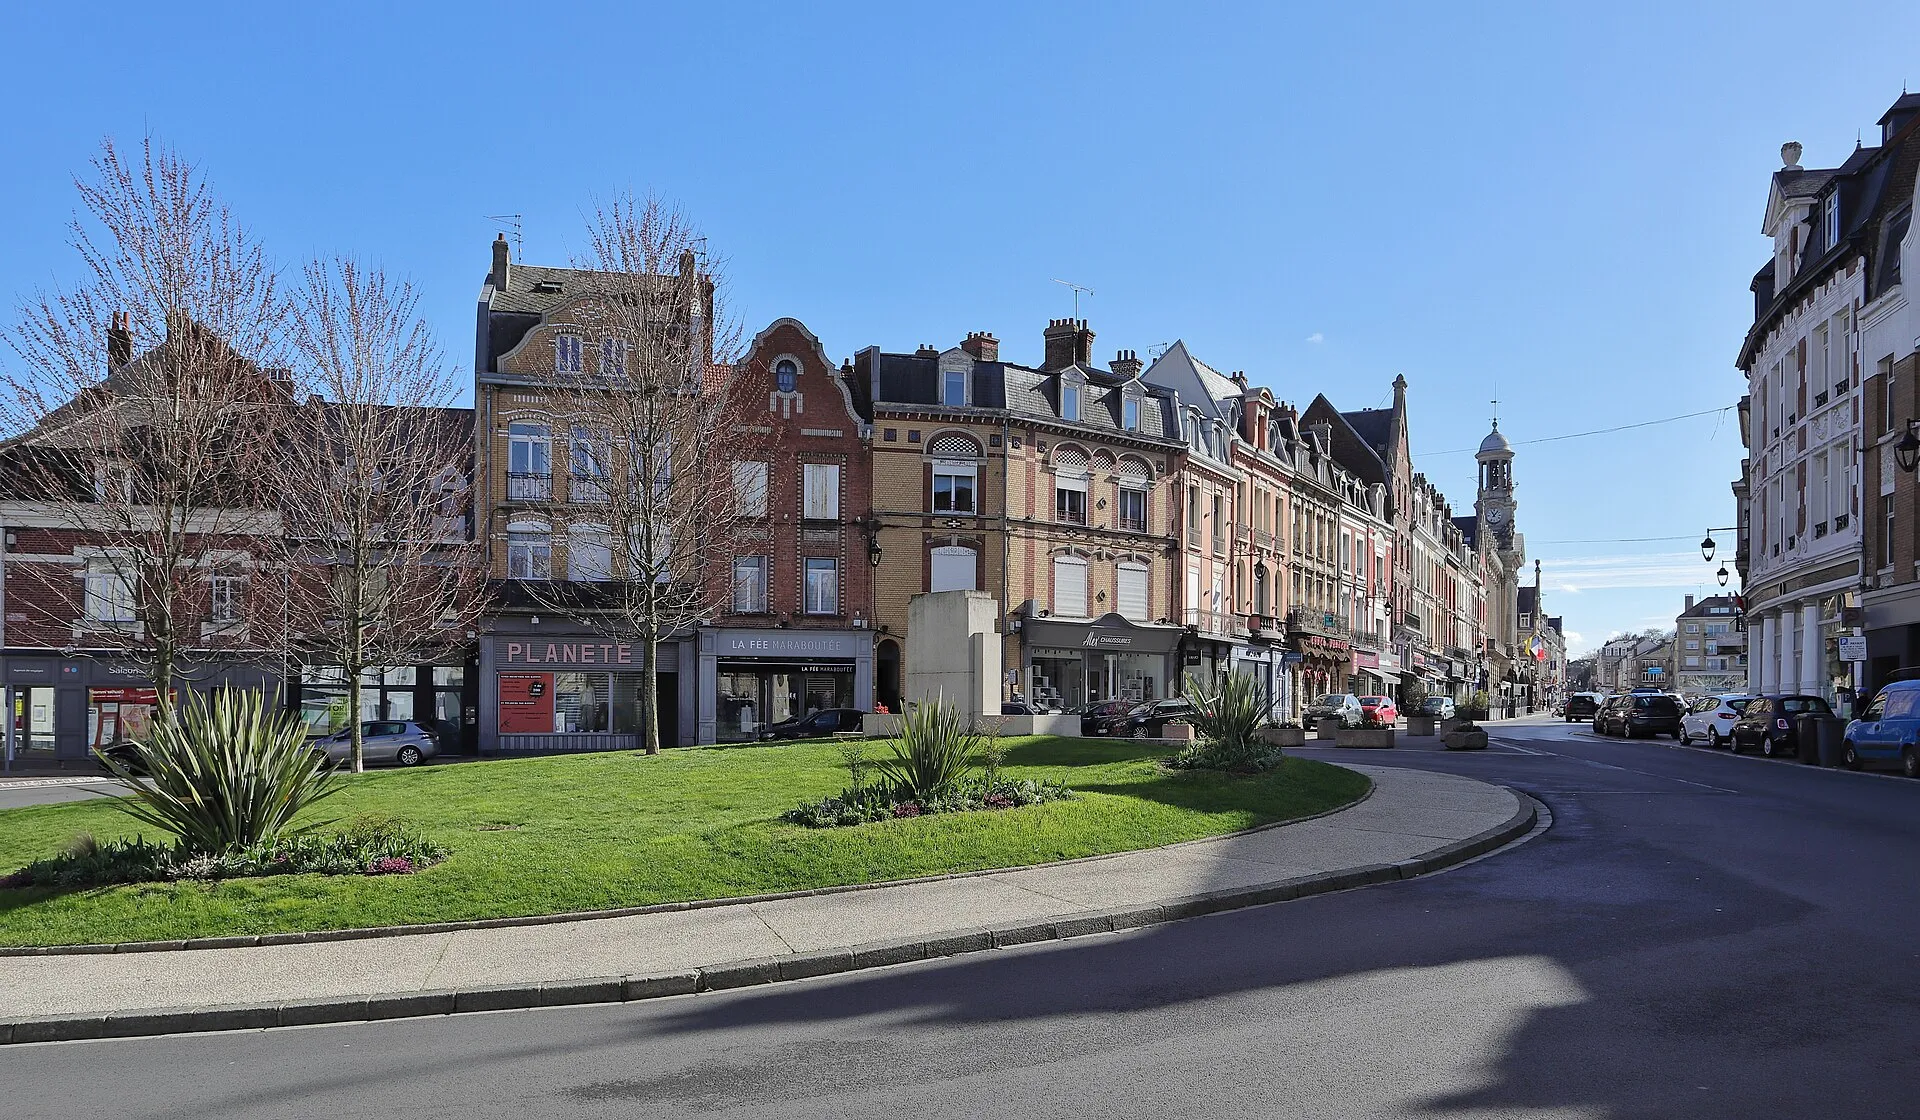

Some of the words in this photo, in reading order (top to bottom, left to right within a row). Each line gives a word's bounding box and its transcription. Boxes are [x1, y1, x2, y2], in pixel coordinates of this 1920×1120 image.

[732, 640, 745, 649] LA
[750, 638, 768, 649] FÉE
[772, 639, 841, 651] MARABOUTÉE
